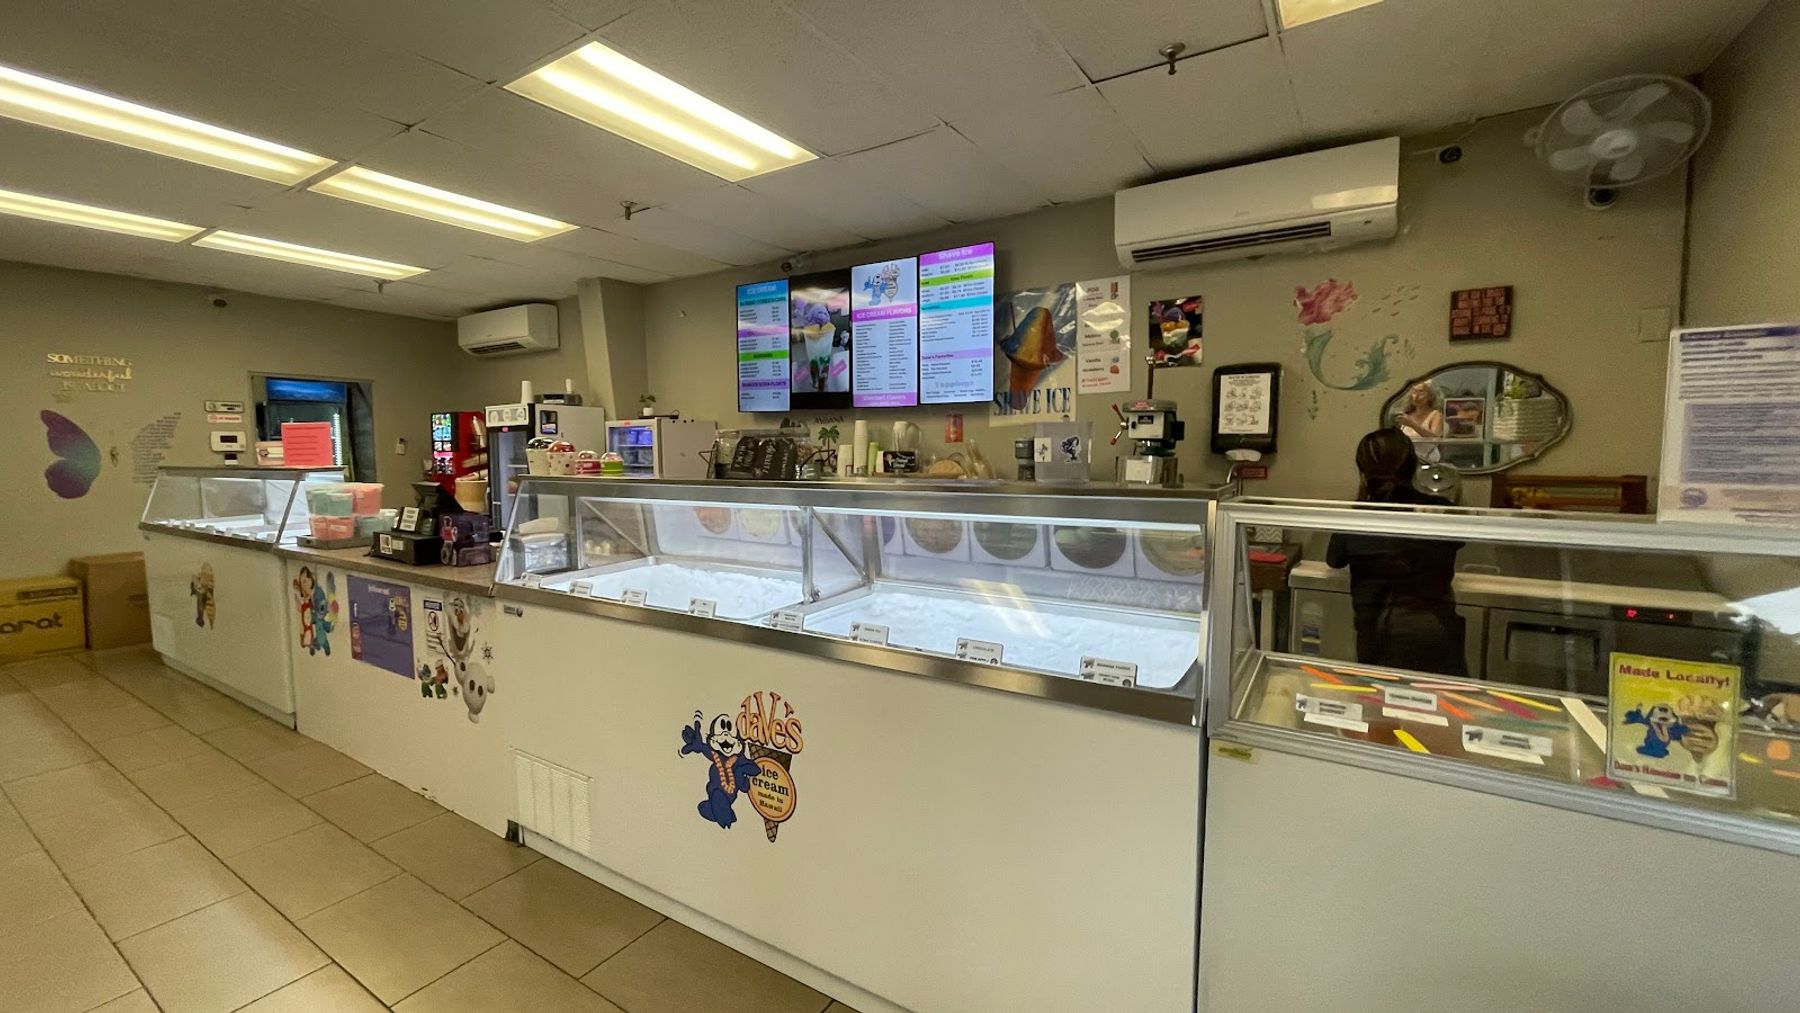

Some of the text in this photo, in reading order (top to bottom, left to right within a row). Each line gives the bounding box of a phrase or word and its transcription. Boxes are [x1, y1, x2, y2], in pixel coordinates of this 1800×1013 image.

[47, 353, 133, 366] SOMETHING
[49, 367, 132, 383] wonderful
[993, 387, 1071, 417] SHE ICE
[1619, 664, 1730, 689] Made Locally!
[761, 765, 779, 780] ice
[752, 776, 789, 797] cream
[757, 791, 784, 804] made in
[759, 799, 783, 813] Hawaii
